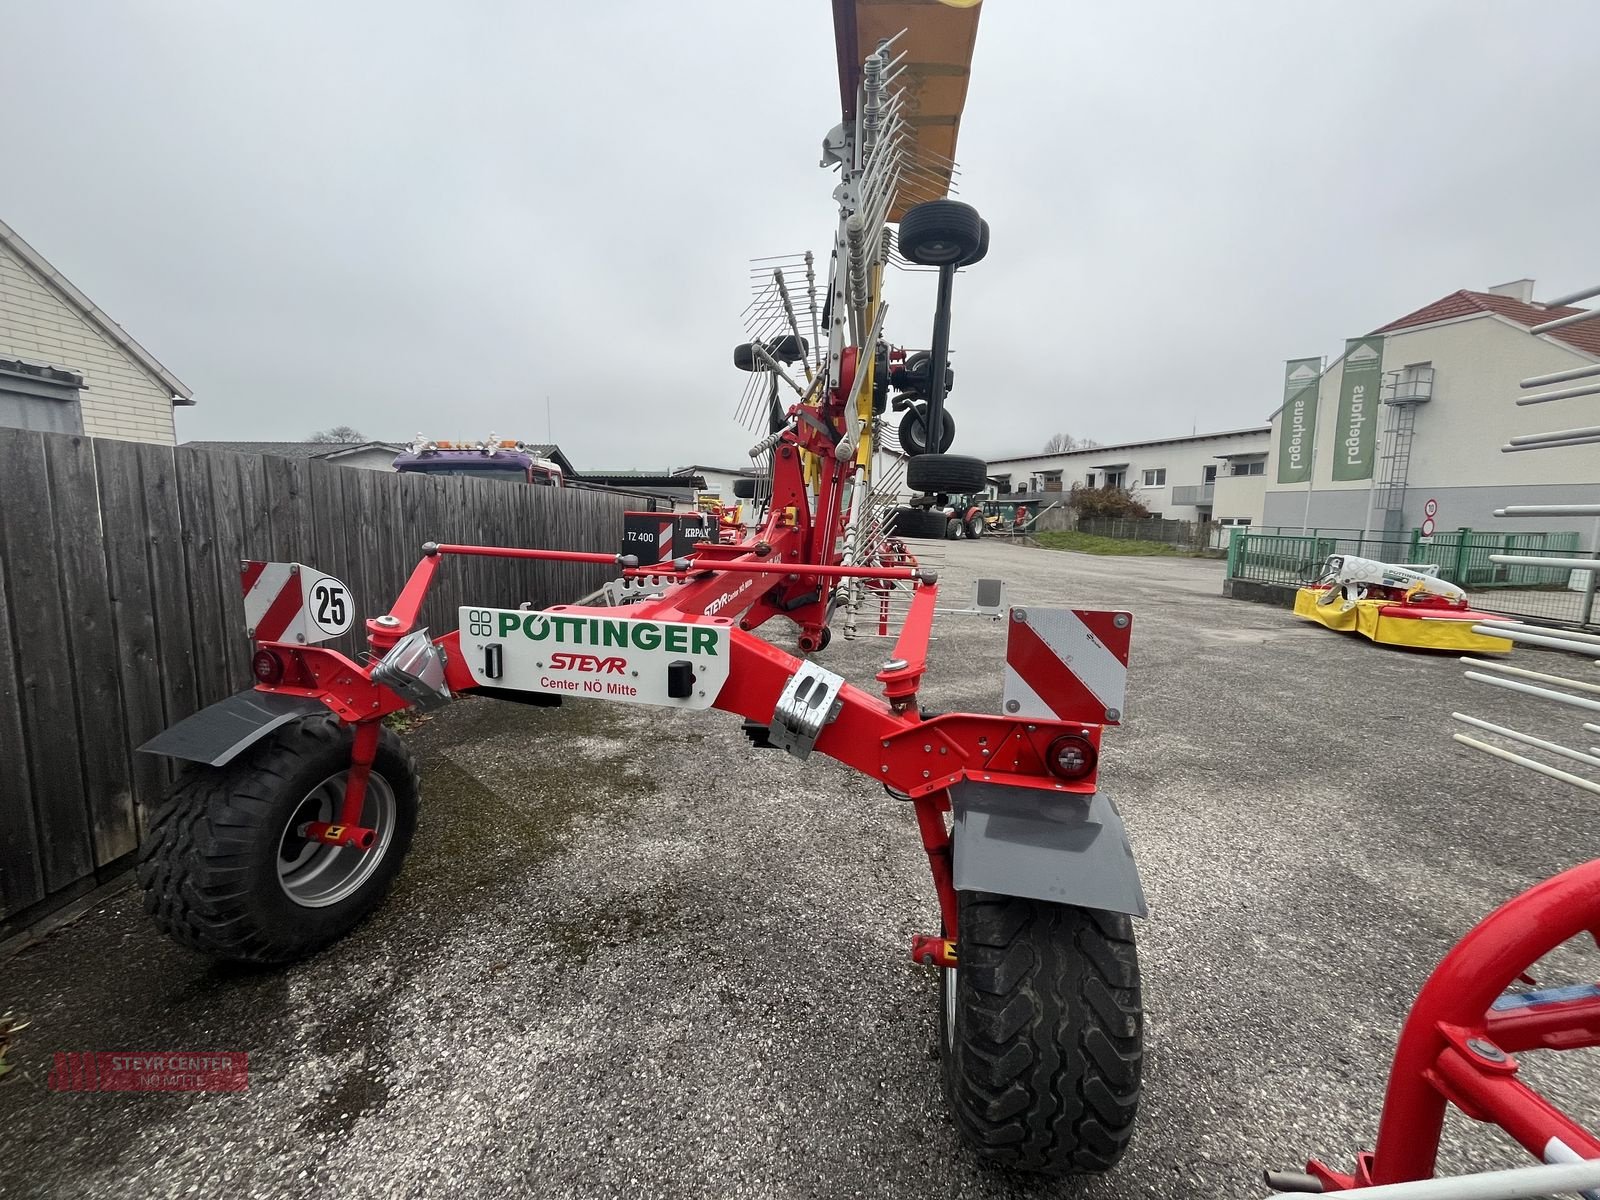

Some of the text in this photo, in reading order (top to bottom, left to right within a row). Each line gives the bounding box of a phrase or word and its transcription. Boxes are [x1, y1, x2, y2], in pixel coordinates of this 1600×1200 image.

[628, 532, 653, 542] TZ 400
[315, 586, 345, 626] 25
[704, 592, 728, 616] STEYR
[498, 612, 719, 656] PÖTTINGER
[549, 652, 627, 675] STEYR
[540, 676, 637, 697] Center NÖ Mitte
